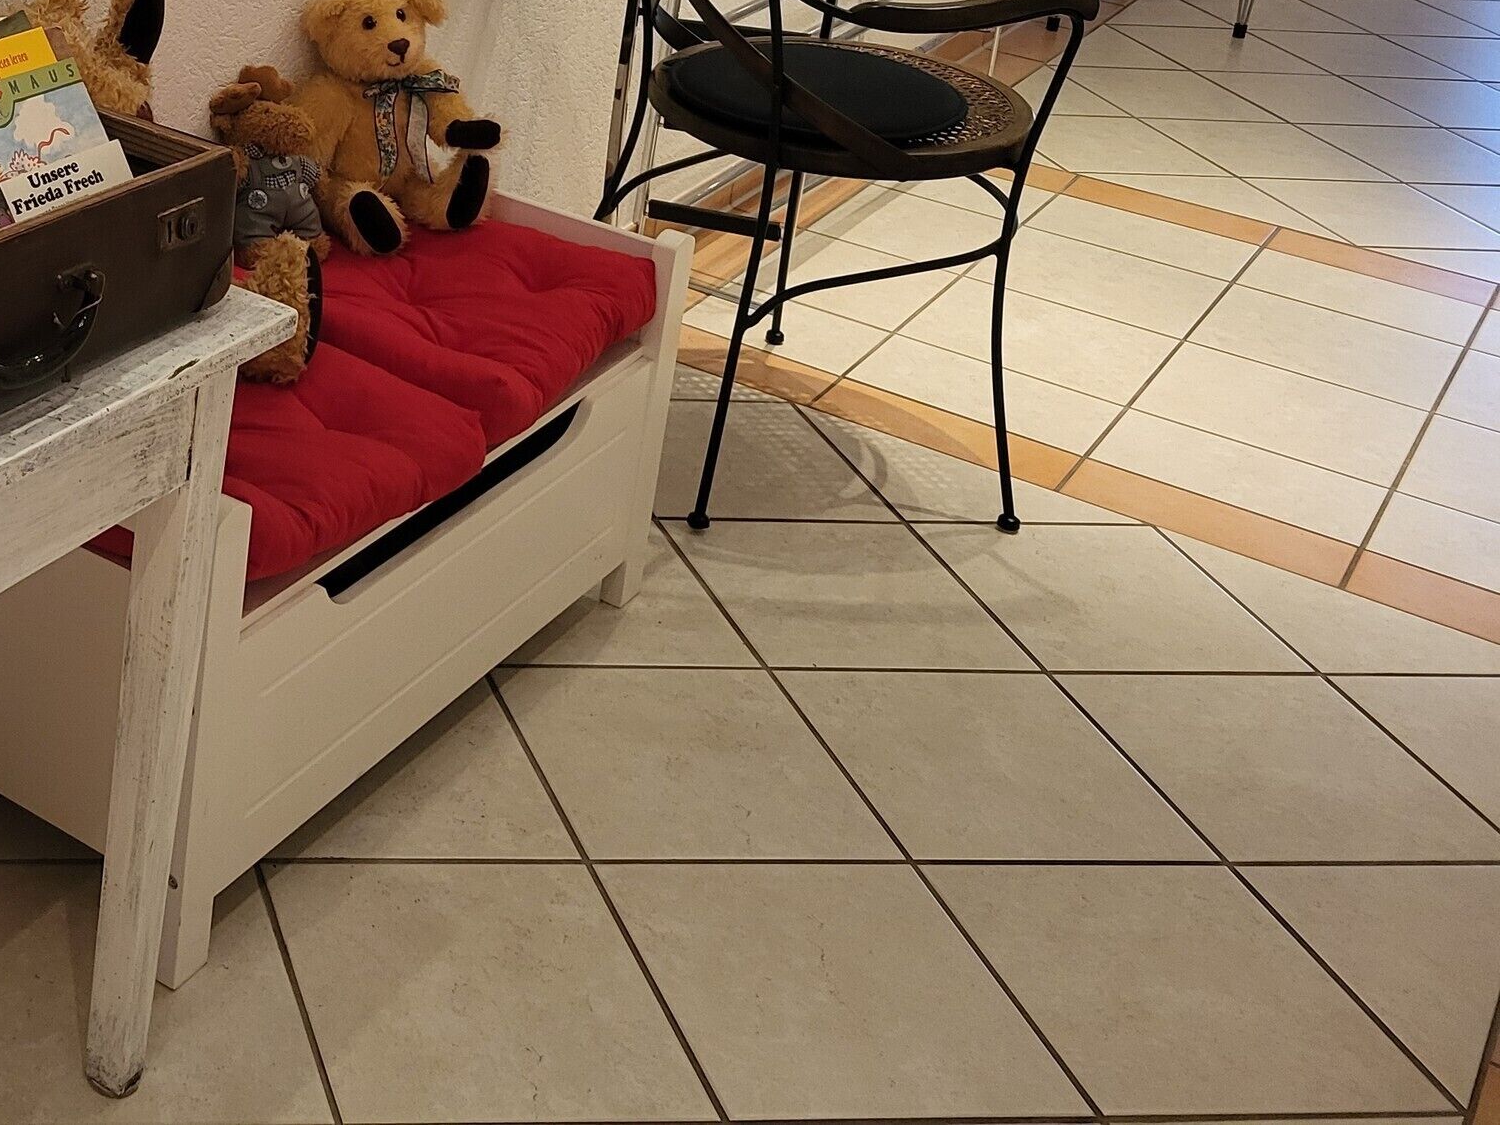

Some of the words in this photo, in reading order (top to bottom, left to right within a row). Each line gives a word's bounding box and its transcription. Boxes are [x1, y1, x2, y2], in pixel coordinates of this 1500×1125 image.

[11, 186, 64, 215] Frieda
[63, 169, 104, 195] Frech
[26, 161, 80, 189] Unsere
